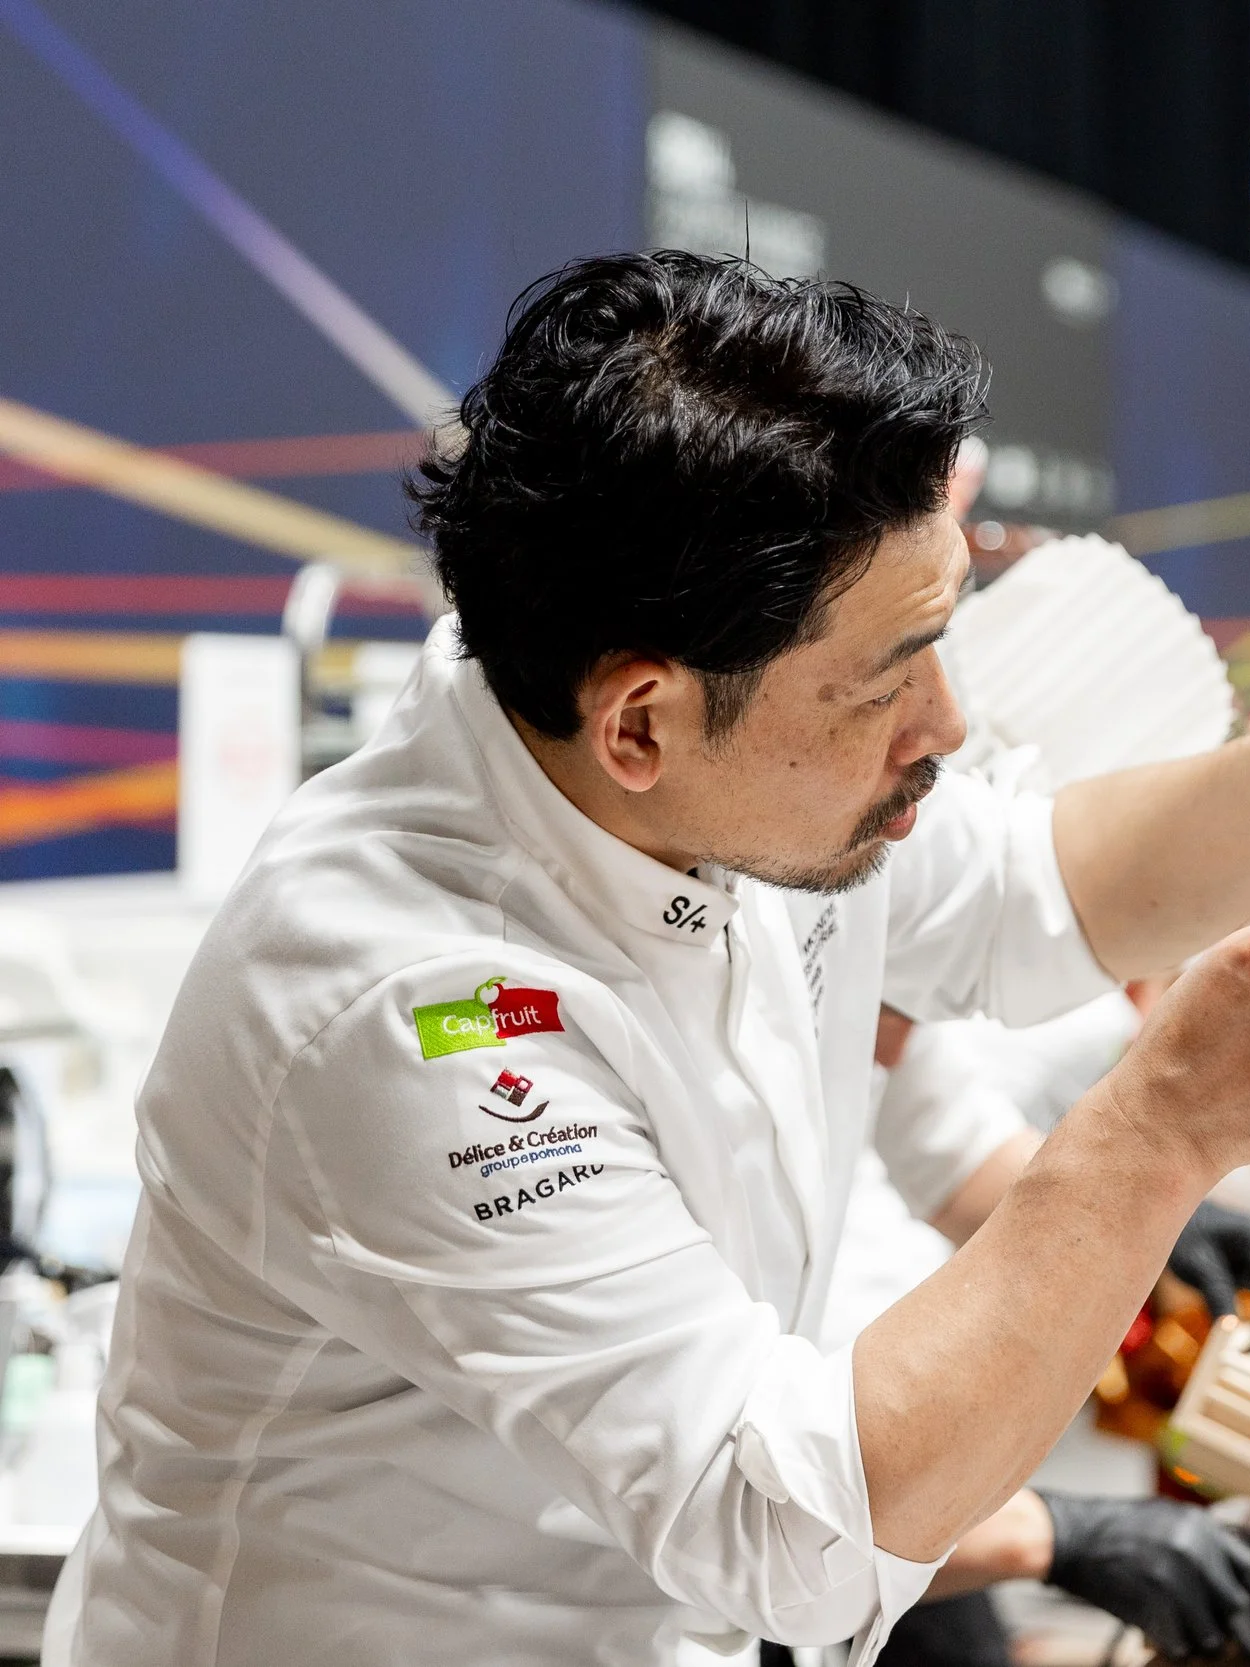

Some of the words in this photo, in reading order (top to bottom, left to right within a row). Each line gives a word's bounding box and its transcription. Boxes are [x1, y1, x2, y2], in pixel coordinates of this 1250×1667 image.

[443, 1005, 541, 1035] Capfruit
[448, 1143, 505, 1168] Délice
[508, 1135, 525, 1152] &
[527, 1123, 598, 1147] Création
